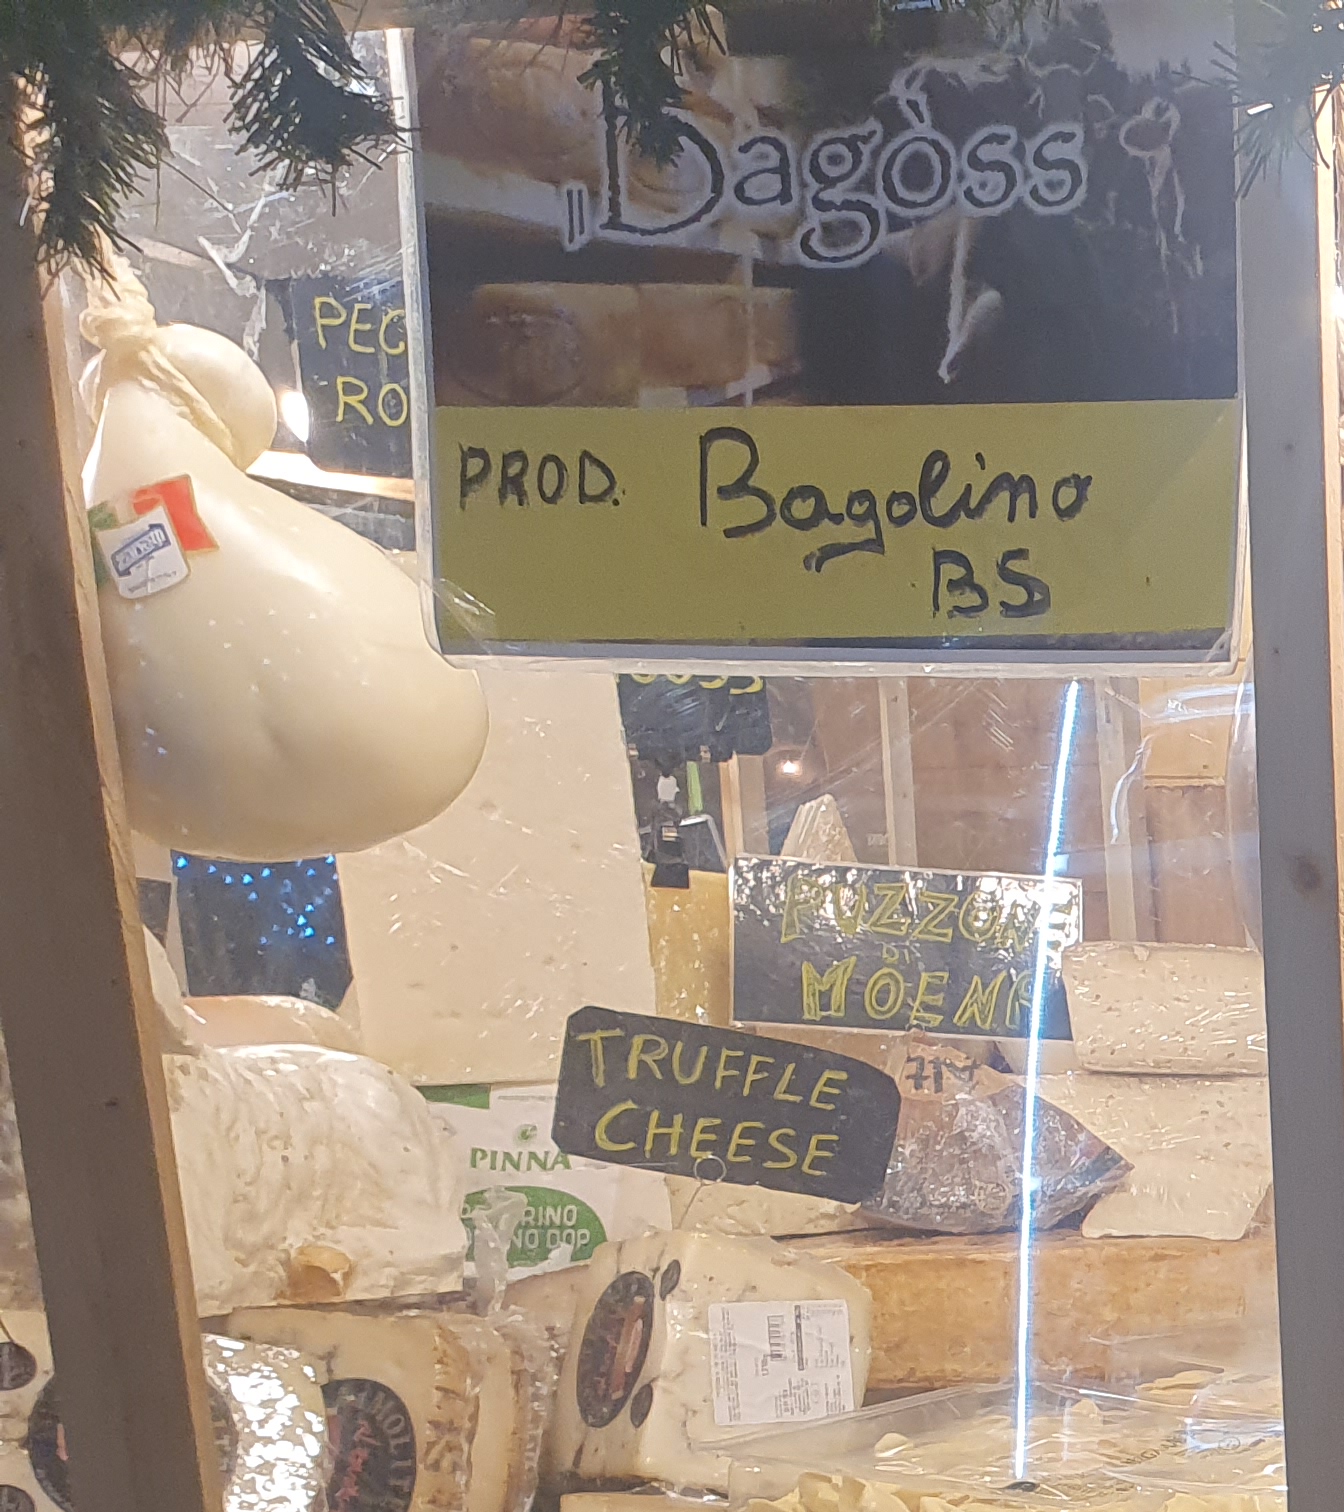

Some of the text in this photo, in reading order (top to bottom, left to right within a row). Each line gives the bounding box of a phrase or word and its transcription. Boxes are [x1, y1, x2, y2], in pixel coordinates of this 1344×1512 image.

[458, 427, 1093, 572] PROD. Bagolino
[932, 548, 1050, 617] BS
[576, 1027, 849, 1111] TRUFFLE
[470, 1147, 573, 1172] PINNA
[595, 1099, 840, 1177] CHEESE
